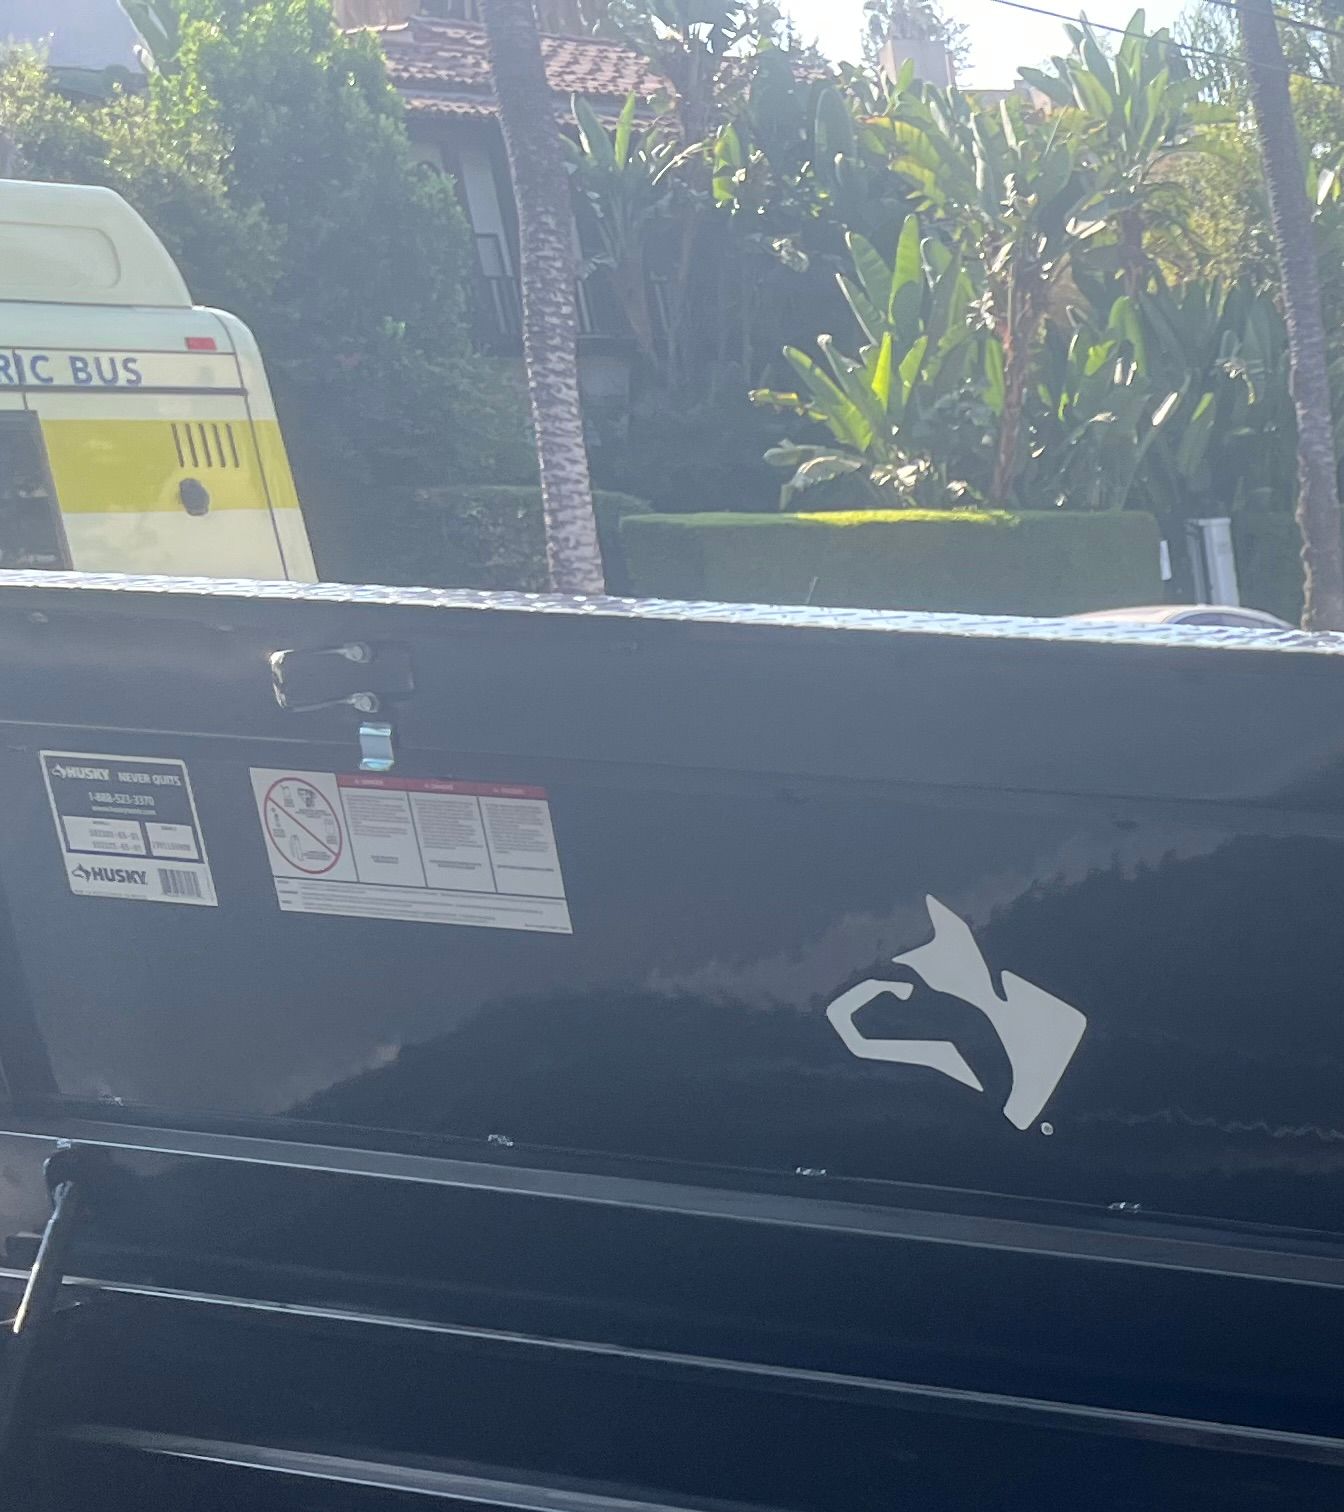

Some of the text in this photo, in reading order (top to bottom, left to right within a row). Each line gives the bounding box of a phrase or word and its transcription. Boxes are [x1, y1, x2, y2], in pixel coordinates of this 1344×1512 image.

[68, 355, 142, 386] BUS
[65, 766, 110, 781] HUSKY
[90, 866, 148, 885] HUSKY
